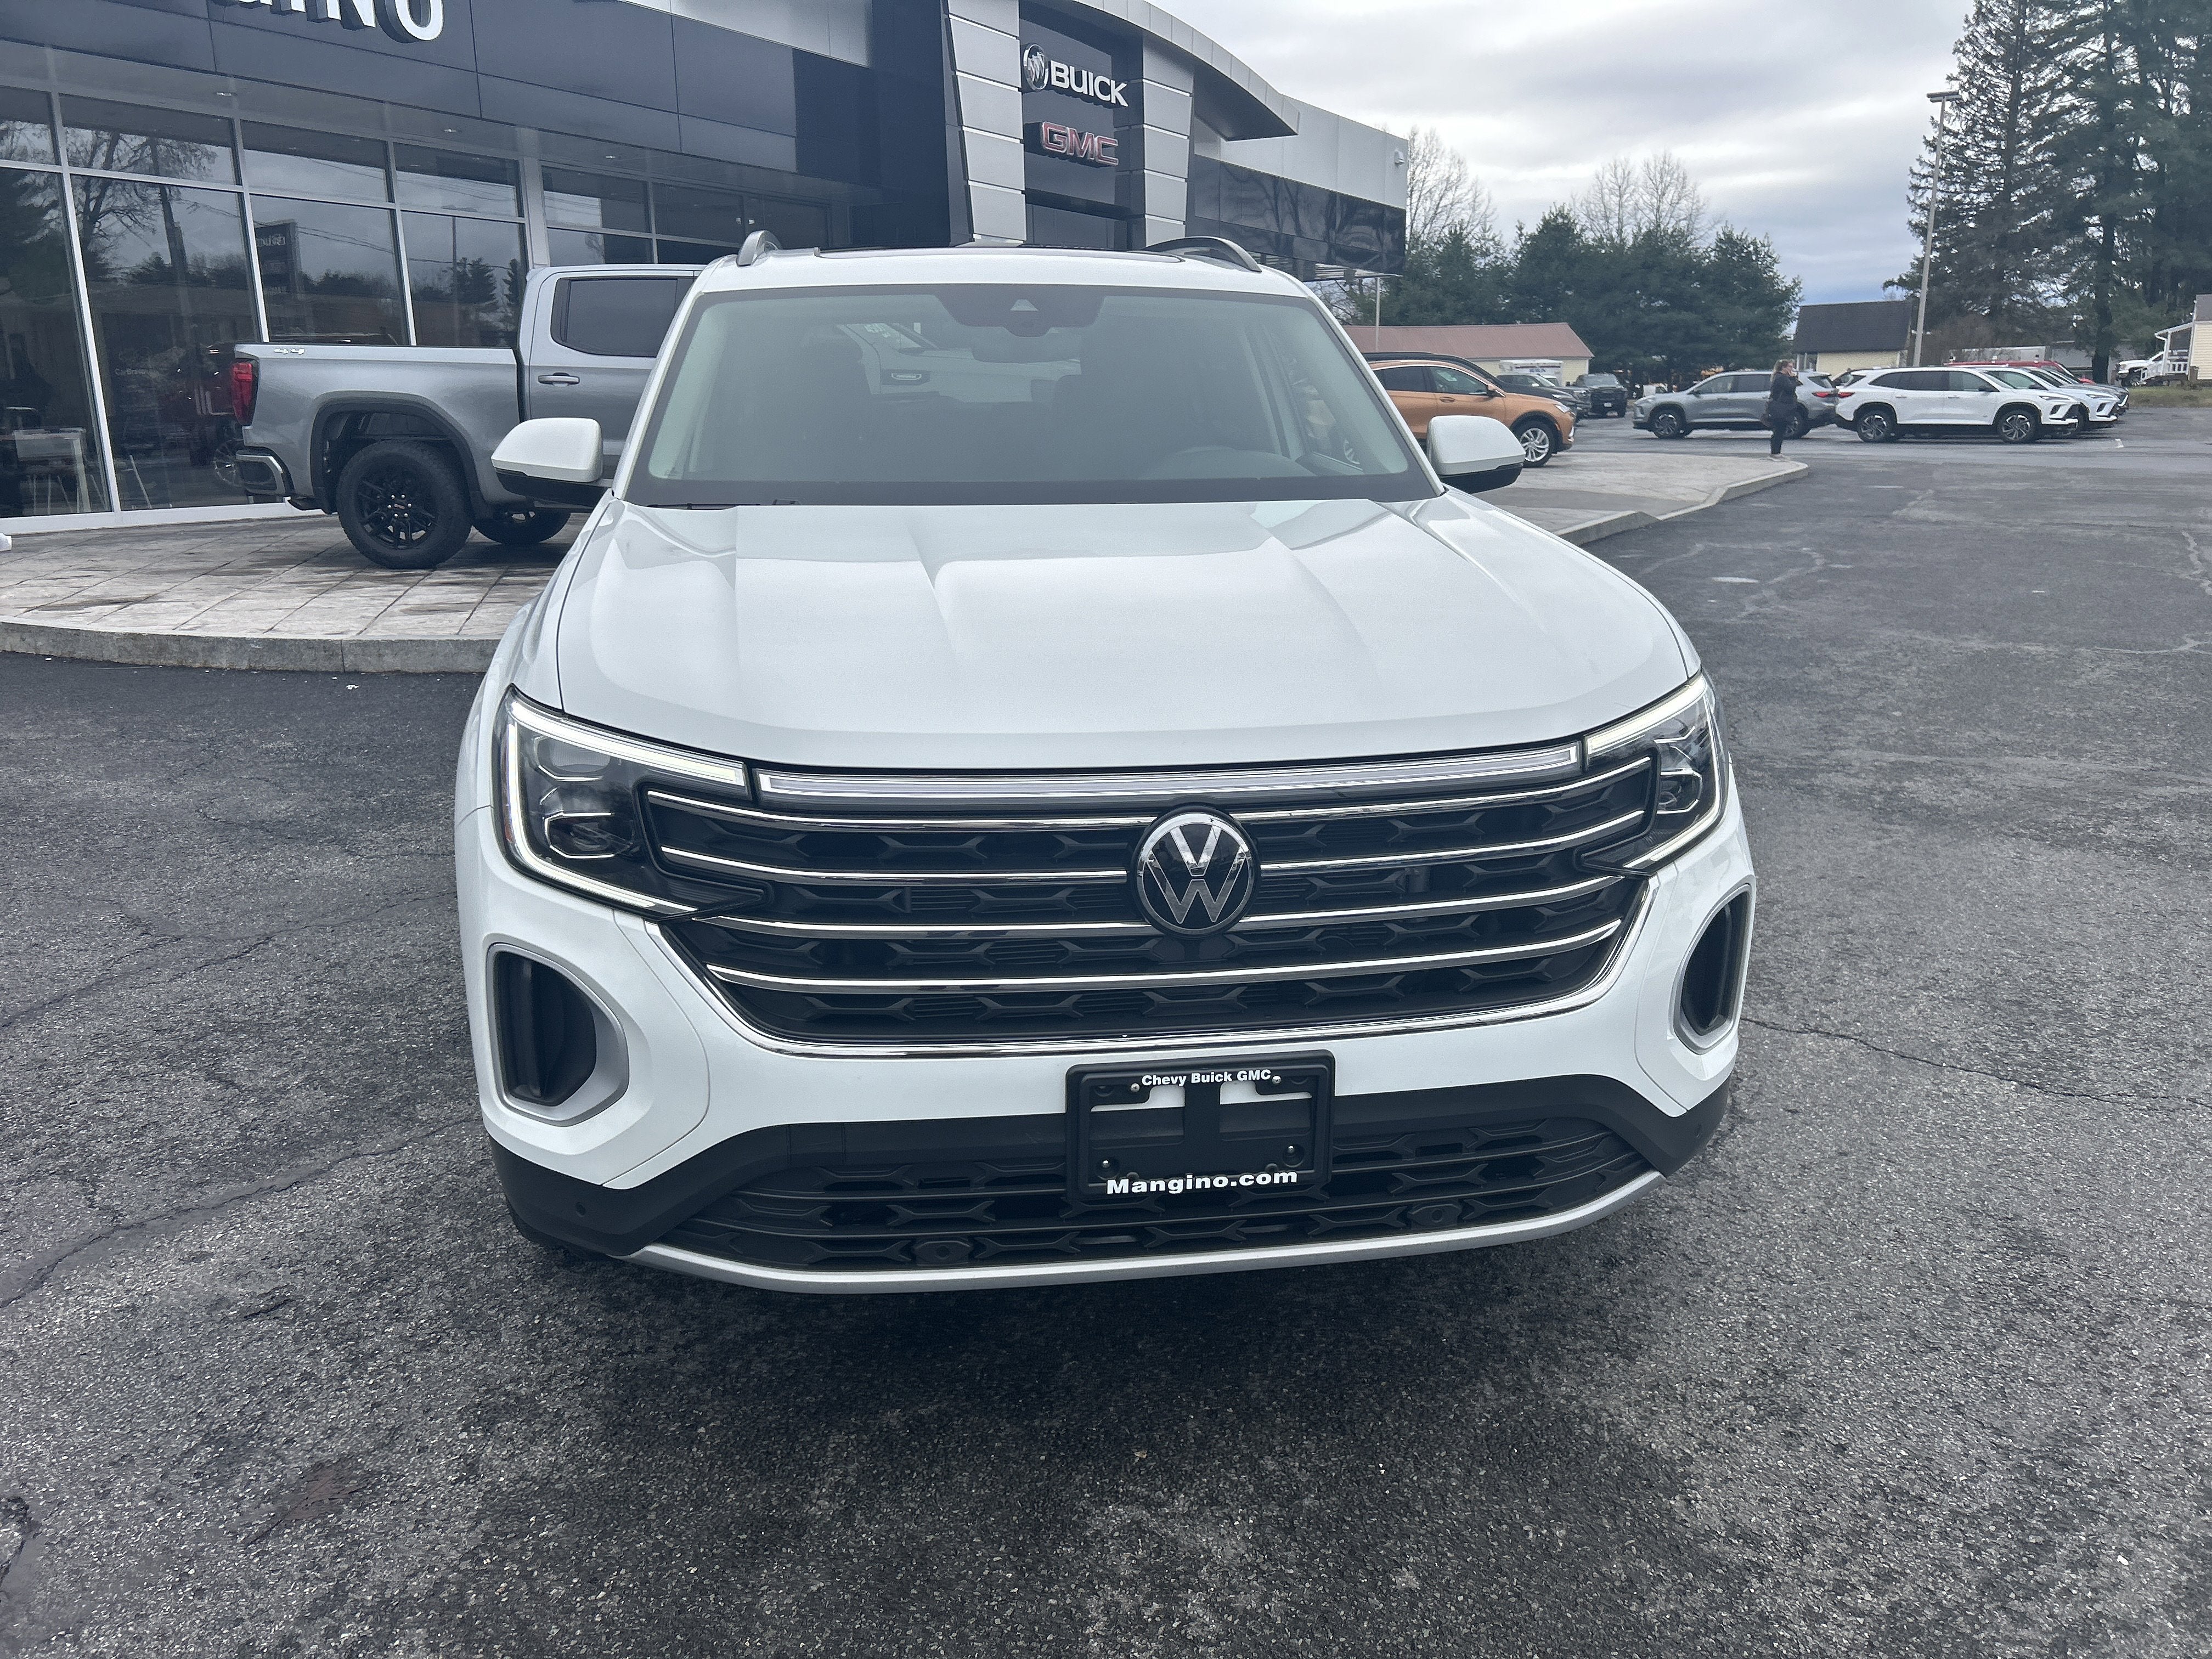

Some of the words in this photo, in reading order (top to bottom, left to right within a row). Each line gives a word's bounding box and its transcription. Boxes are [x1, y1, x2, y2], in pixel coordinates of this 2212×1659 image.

[1051, 60, 1128, 107] BUICK
[1042, 121, 1119, 166] GMC
[1142, 1075, 1187, 1087] Chevy
[1191, 1071, 1232, 1084] Buick
[1237, 1069, 1271, 1081] GMC
[1107, 1170, 1297, 1194] Mangino.com
